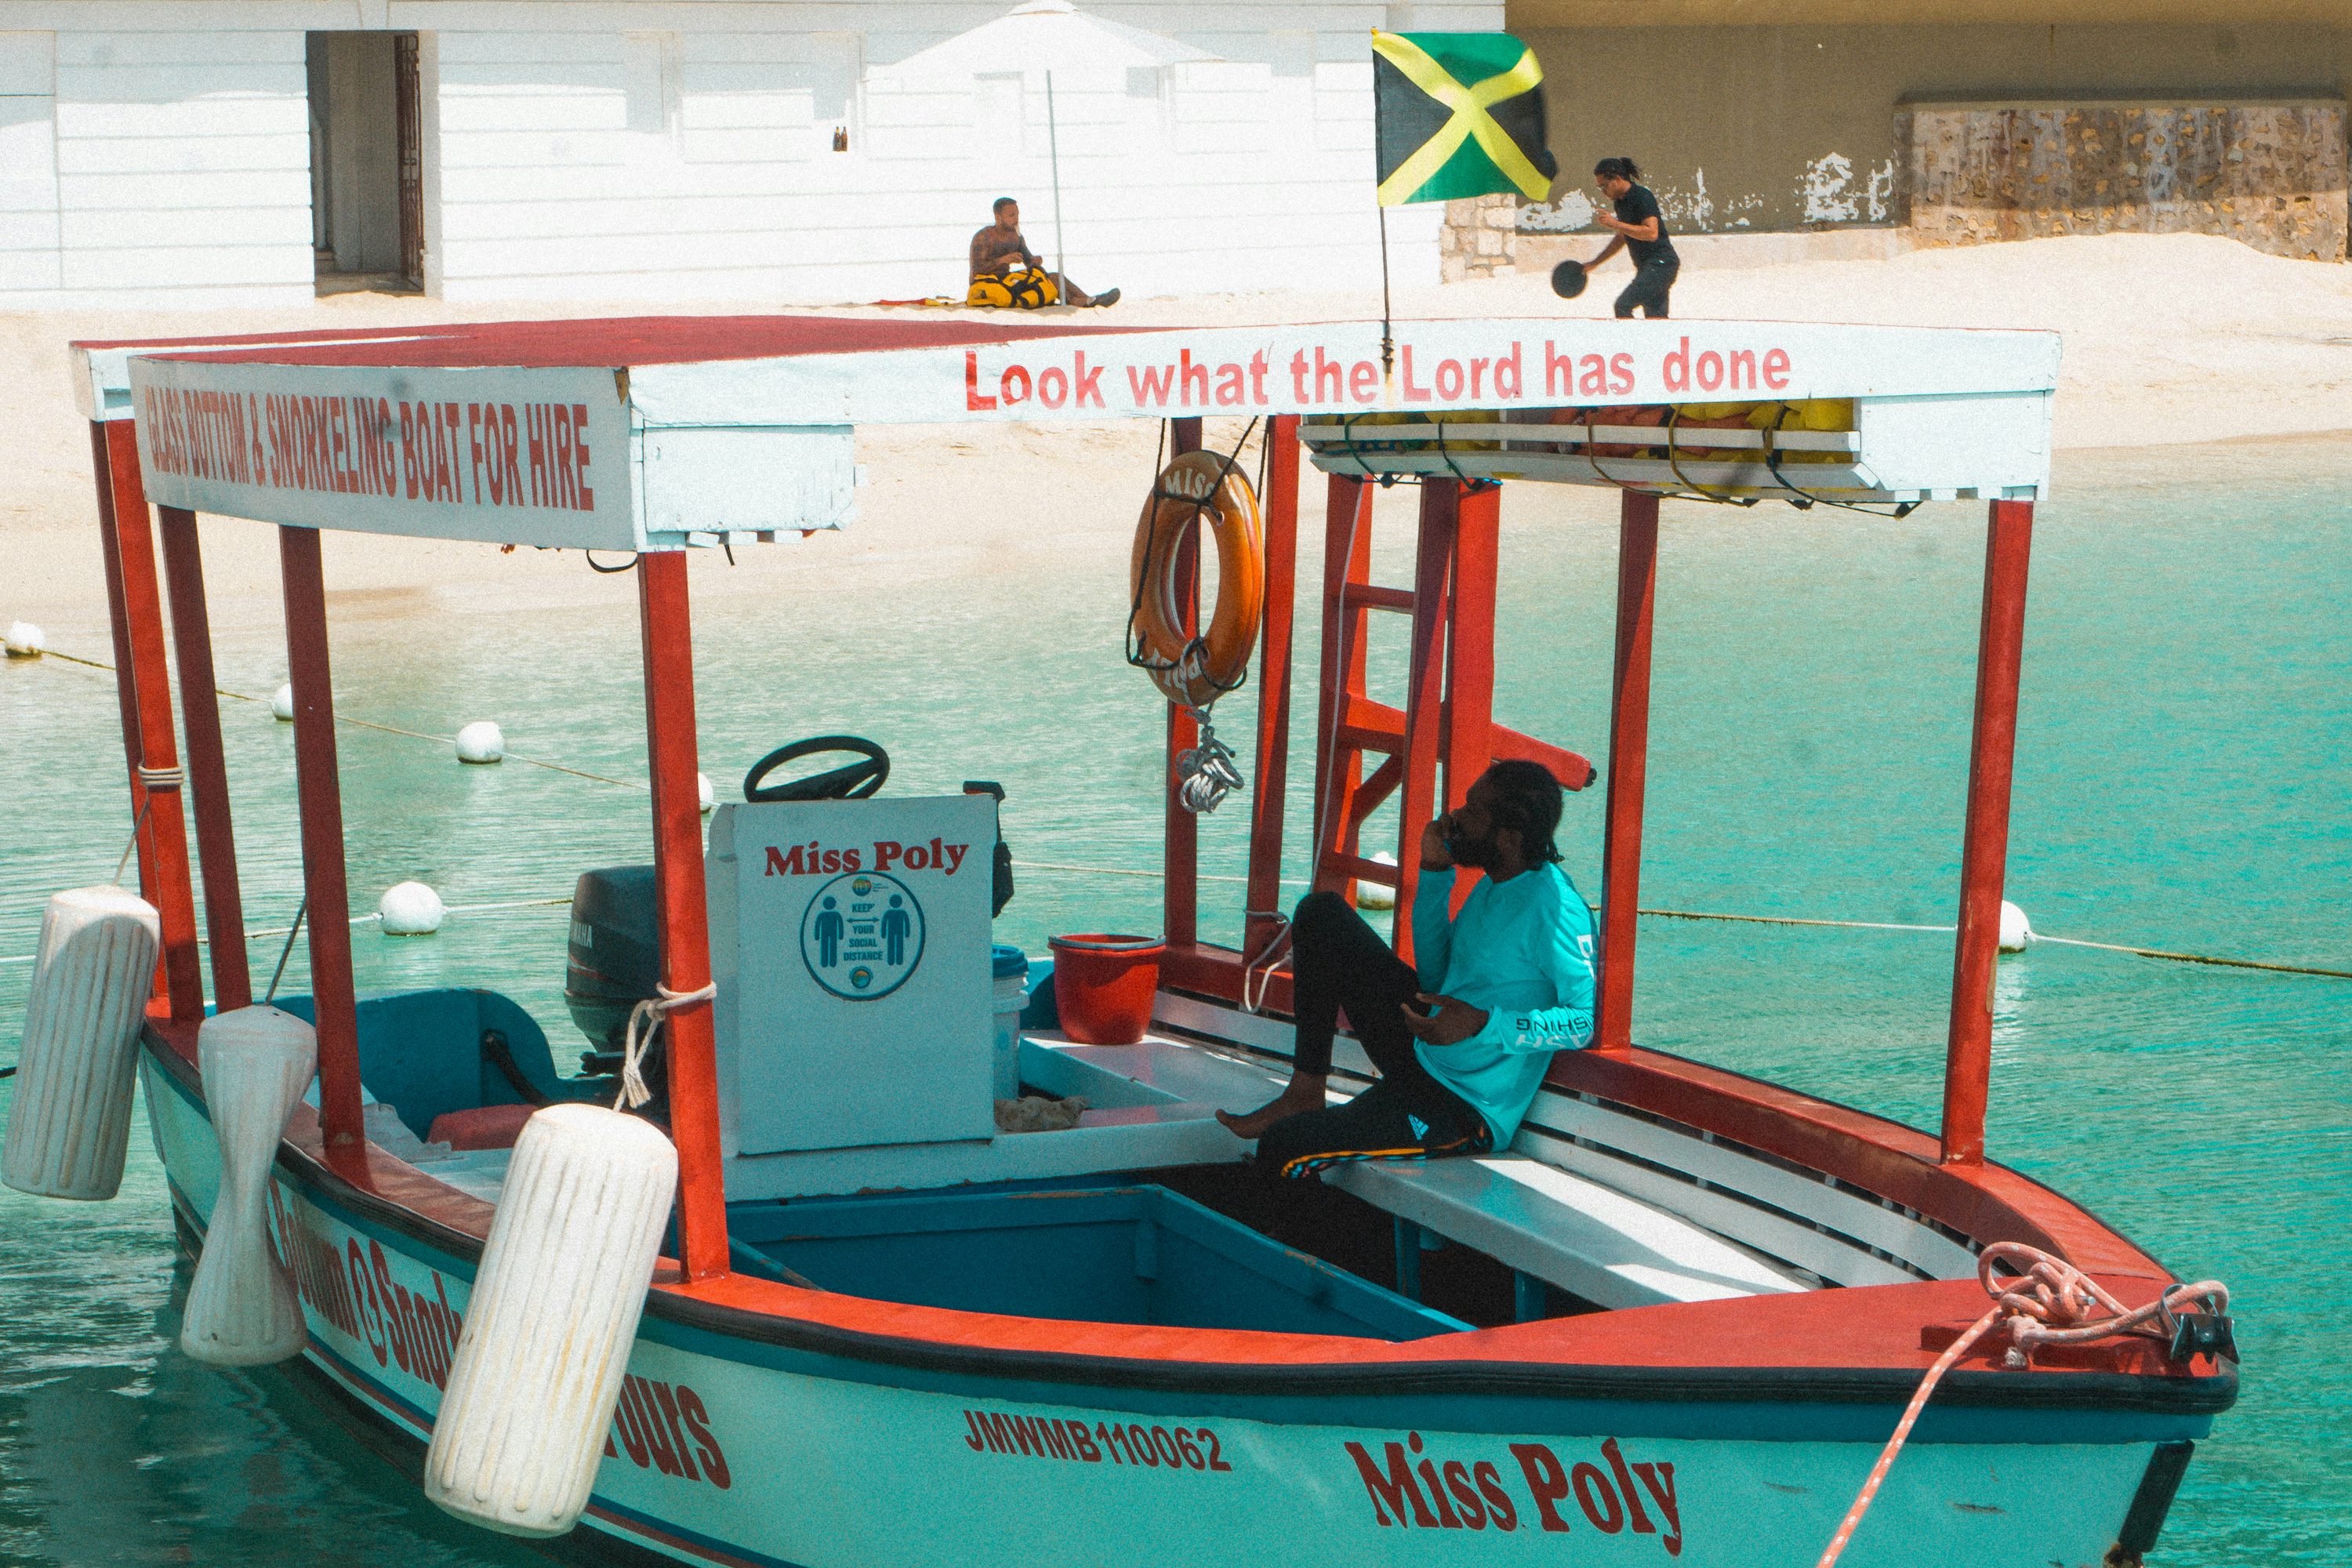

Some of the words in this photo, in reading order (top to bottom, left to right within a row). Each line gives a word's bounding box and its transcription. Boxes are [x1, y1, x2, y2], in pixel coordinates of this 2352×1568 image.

[965, 350, 1105, 411] Look
[1127, 348, 1269, 407] what
[1290, 345, 1378, 404] the
[1402, 341, 1523, 401] Lord
[1545, 339, 1634, 397] has
[1661, 336, 1791, 391] done
[145, 385, 188, 477] GLASS
[183, 389, 250, 485] BOTTOM
[249, 392, 267, 487] &
[267, 393, 397, 497] SNORKELING
[399, 401, 463, 503] BOAT
[469, 401, 524, 507] FOR
[525, 403, 594, 511] HIRE
[764, 840, 862, 877] Miss
[873, 837, 970, 876] Poly
[851, 903, 876, 913] KEEP
[849, 938, 878, 948] SOCIAL
[852, 924, 875, 935] YOUR
[843, 951, 884, 961] DISTANCE
[964, 1410, 1232, 1472] JMWMB110062
[1345, 1432, 1518, 1531] Miss
[1511, 1436, 1682, 1556] Poly
